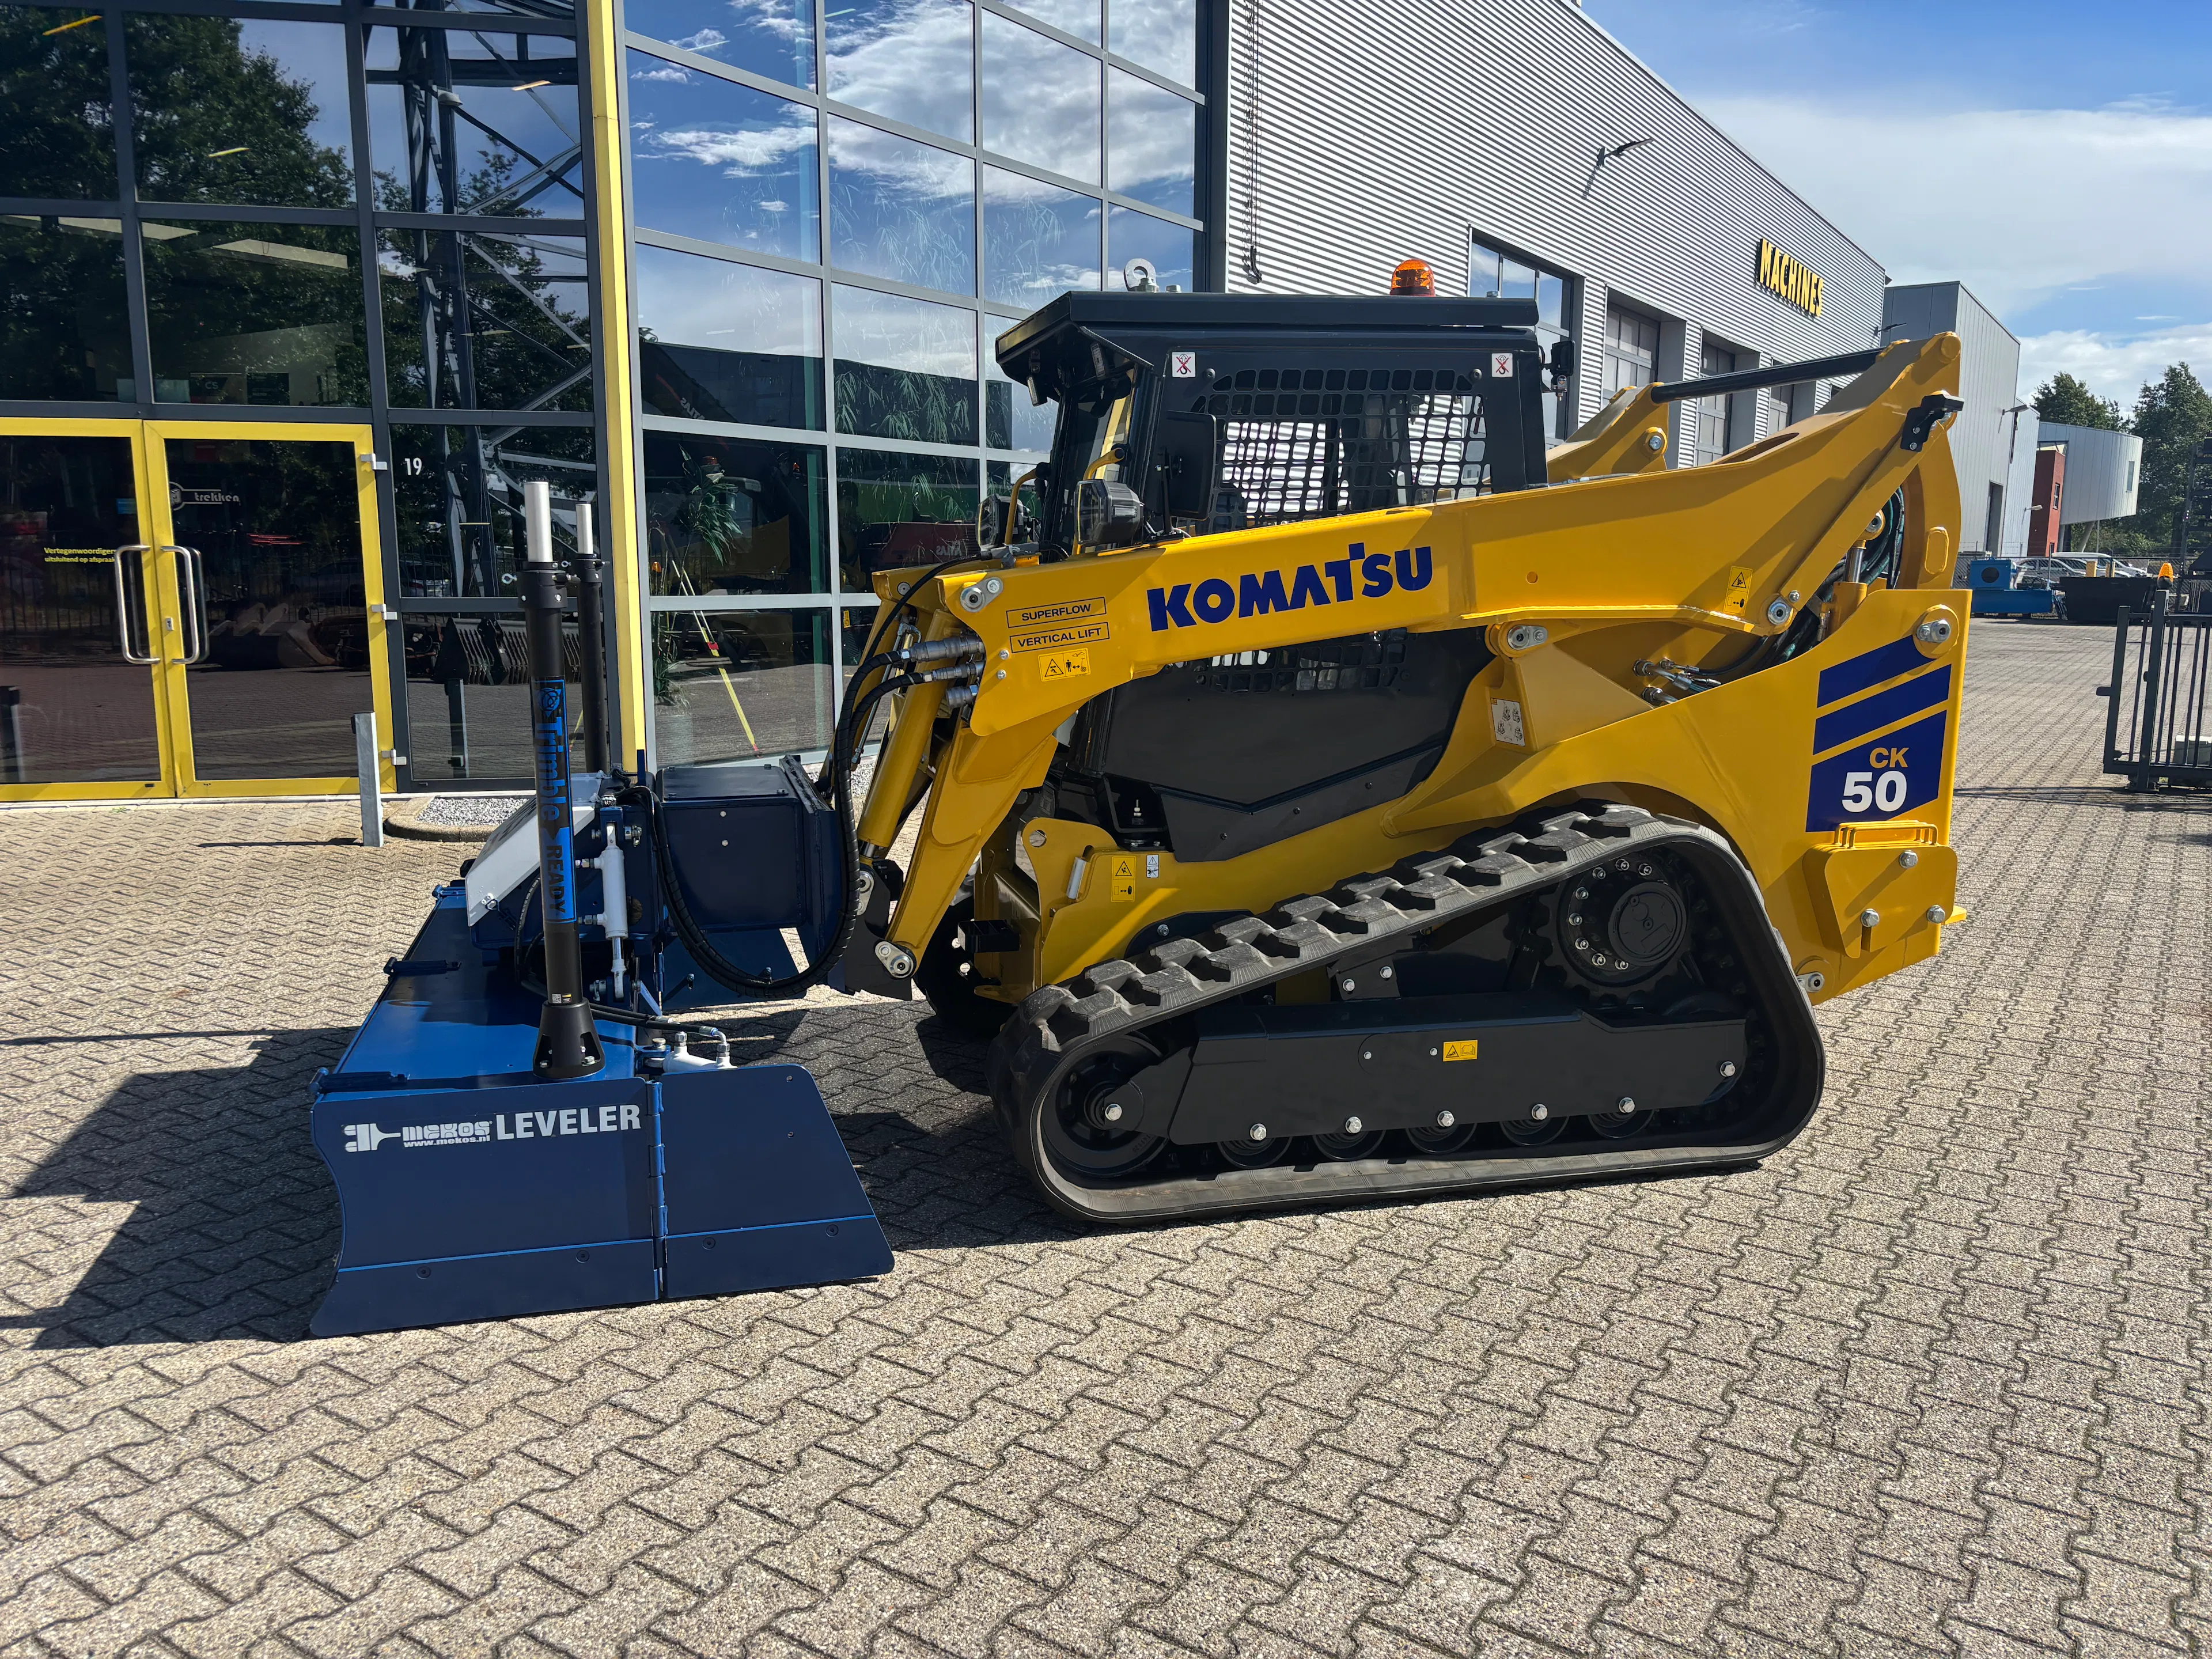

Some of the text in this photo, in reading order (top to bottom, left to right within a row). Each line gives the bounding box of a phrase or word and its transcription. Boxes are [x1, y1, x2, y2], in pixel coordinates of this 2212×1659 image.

[1758, 238, 1825, 317] MACHINES
[404, 457, 422, 475] 19
[1146, 542, 1433, 632] KOMATSU
[1021, 604, 1091, 621] SUPERFLOW
[1018, 627, 1101, 647] VERTICAL LIFT
[536, 717, 566, 821] Trimble
[1869, 747, 1910, 768] CK
[1842, 771, 1907, 812] 50
[546, 844, 566, 914] READY
[496, 1104, 641, 1141] LEVELER
[404, 1135, 490, 1148] www.mekos.nl
